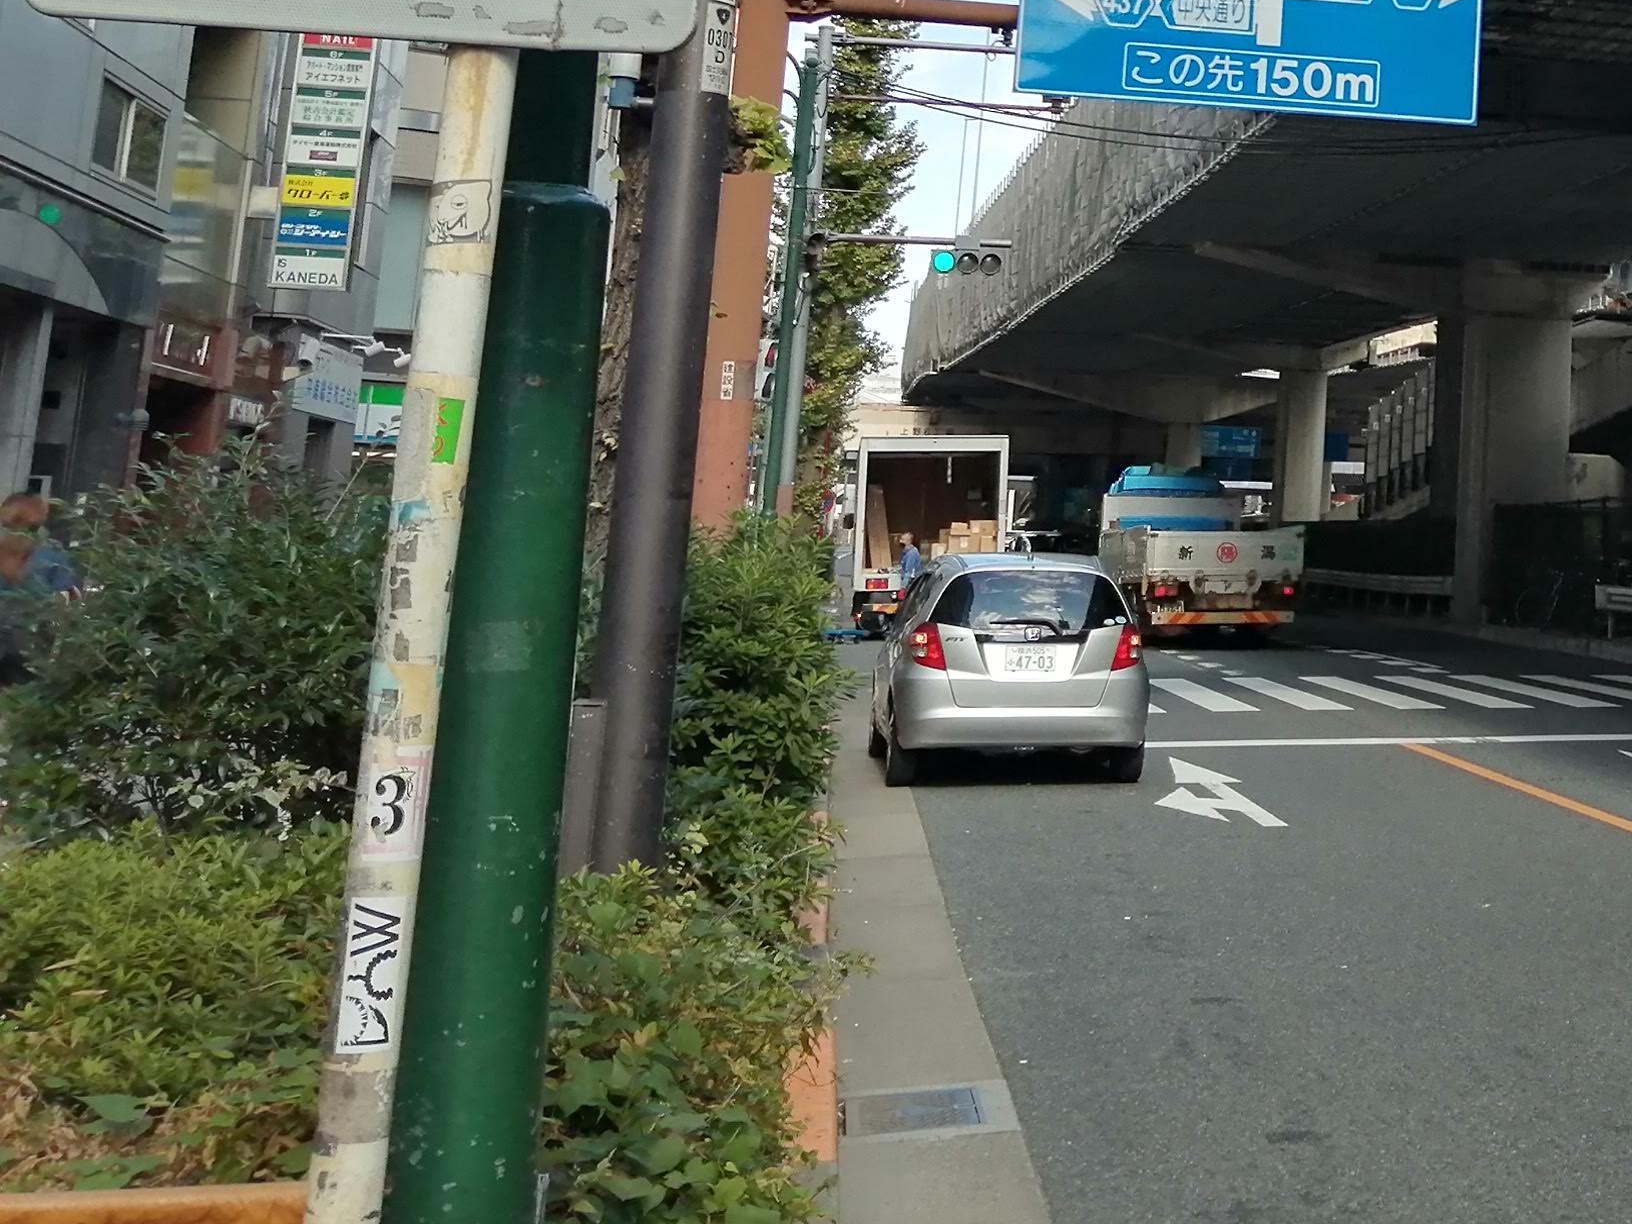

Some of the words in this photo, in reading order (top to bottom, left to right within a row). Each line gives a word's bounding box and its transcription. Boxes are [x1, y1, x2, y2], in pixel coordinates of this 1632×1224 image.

[321, 35, 356, 45] NAIL
[288, 188, 337, 200] クローバー
[275, 271, 338, 285] KANEDA
[1016, 656, 1054, 669] 47-03
